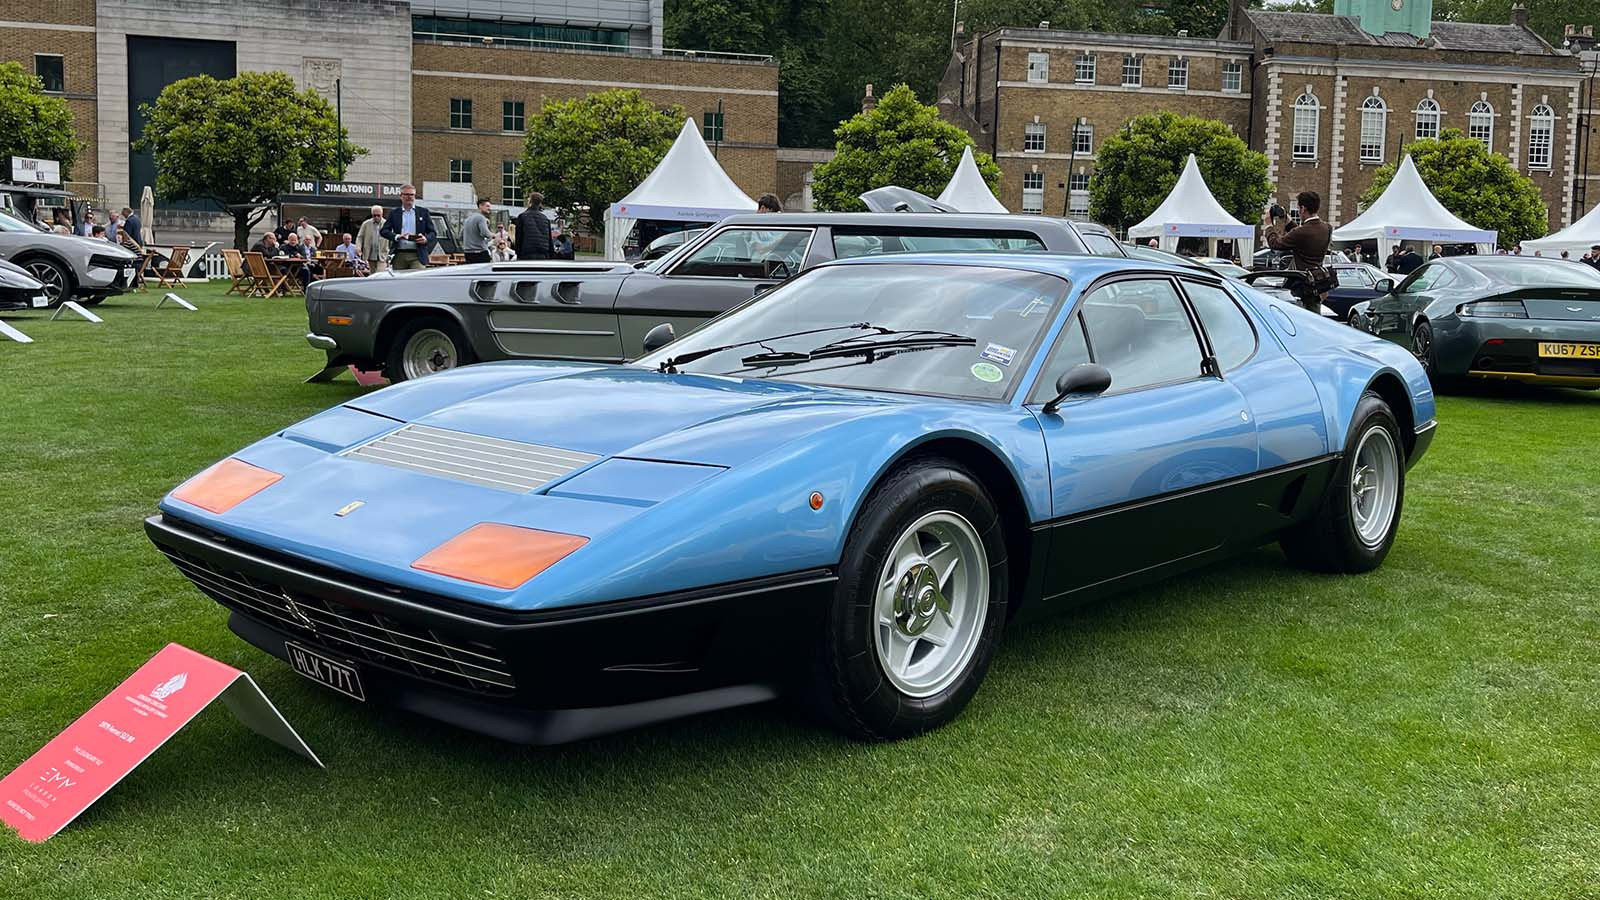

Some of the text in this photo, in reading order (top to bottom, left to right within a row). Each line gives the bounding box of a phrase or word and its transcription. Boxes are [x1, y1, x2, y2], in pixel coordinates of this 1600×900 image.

[294, 182, 314, 192] BAR
[323, 183, 374, 194] JIM&TONIC
[1544, 344, 1577, 355] KU67
[292, 648, 354, 693] HLK 77T
